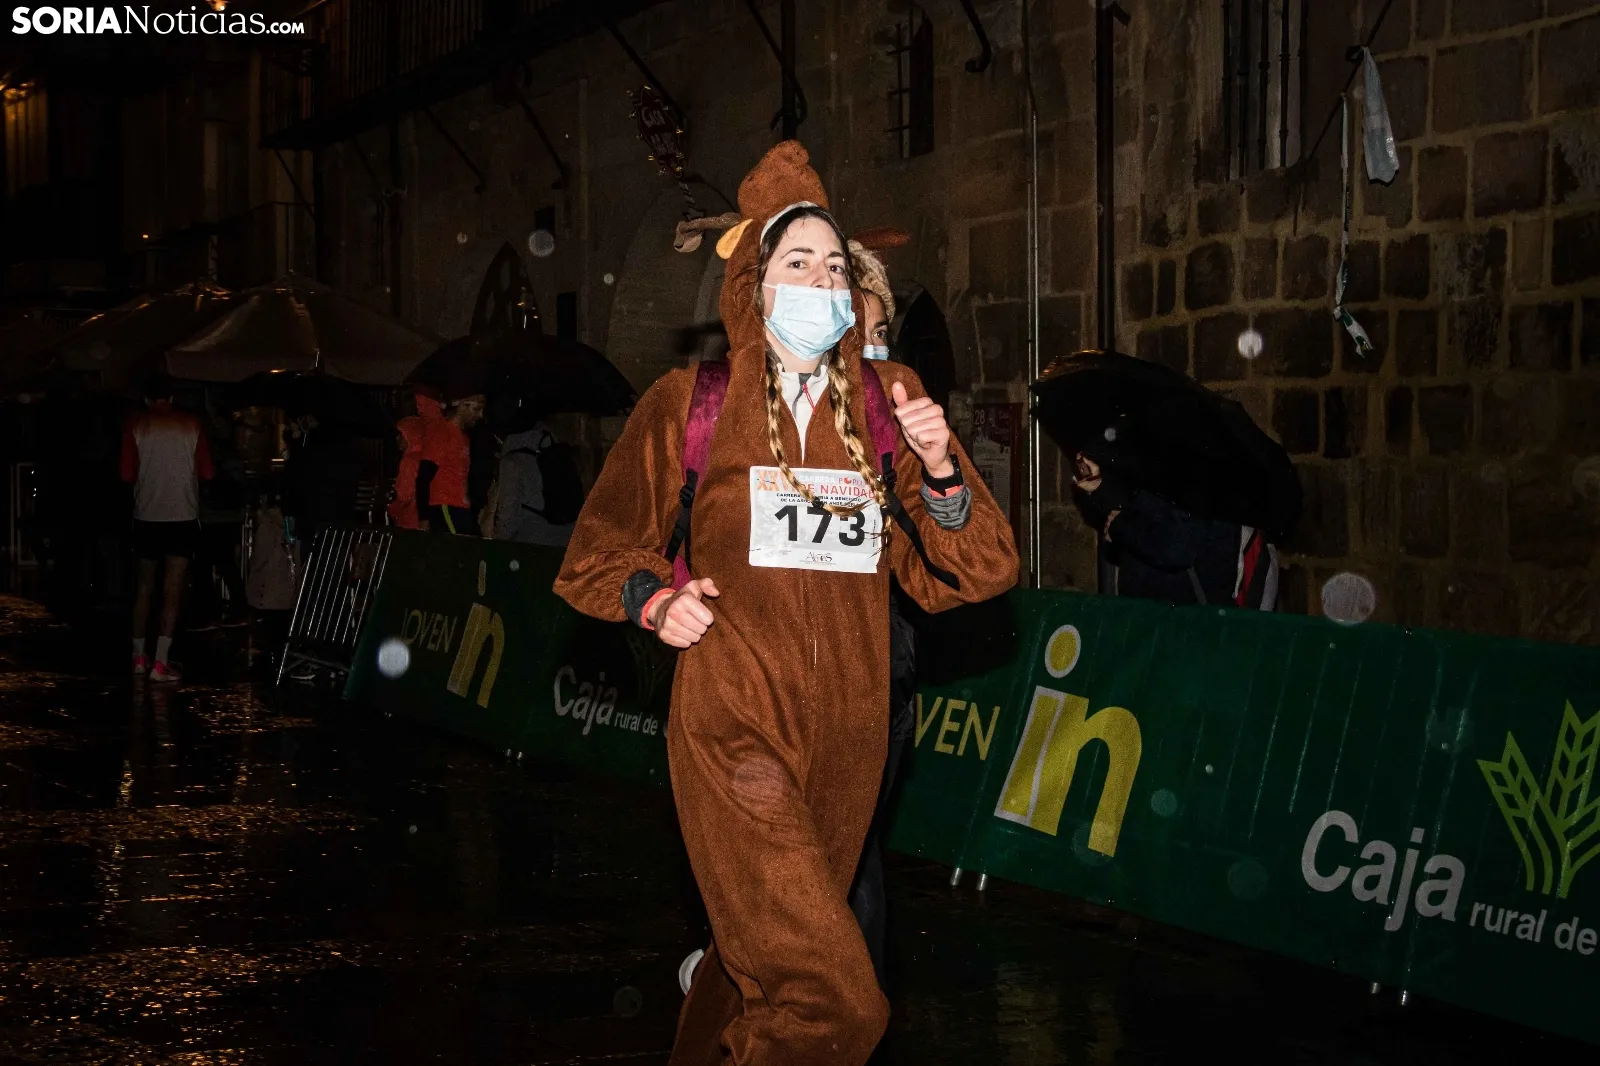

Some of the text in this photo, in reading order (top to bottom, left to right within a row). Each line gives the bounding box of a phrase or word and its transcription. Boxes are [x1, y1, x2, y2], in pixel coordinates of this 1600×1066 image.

[774, 504, 866, 547] 173
[553, 664, 619, 736] Caja
[614, 708, 641, 732] rural
[643, 713, 659, 736] de
[913, 692, 1001, 762] VEN
[1301, 809, 1599, 956] Caja rural de
